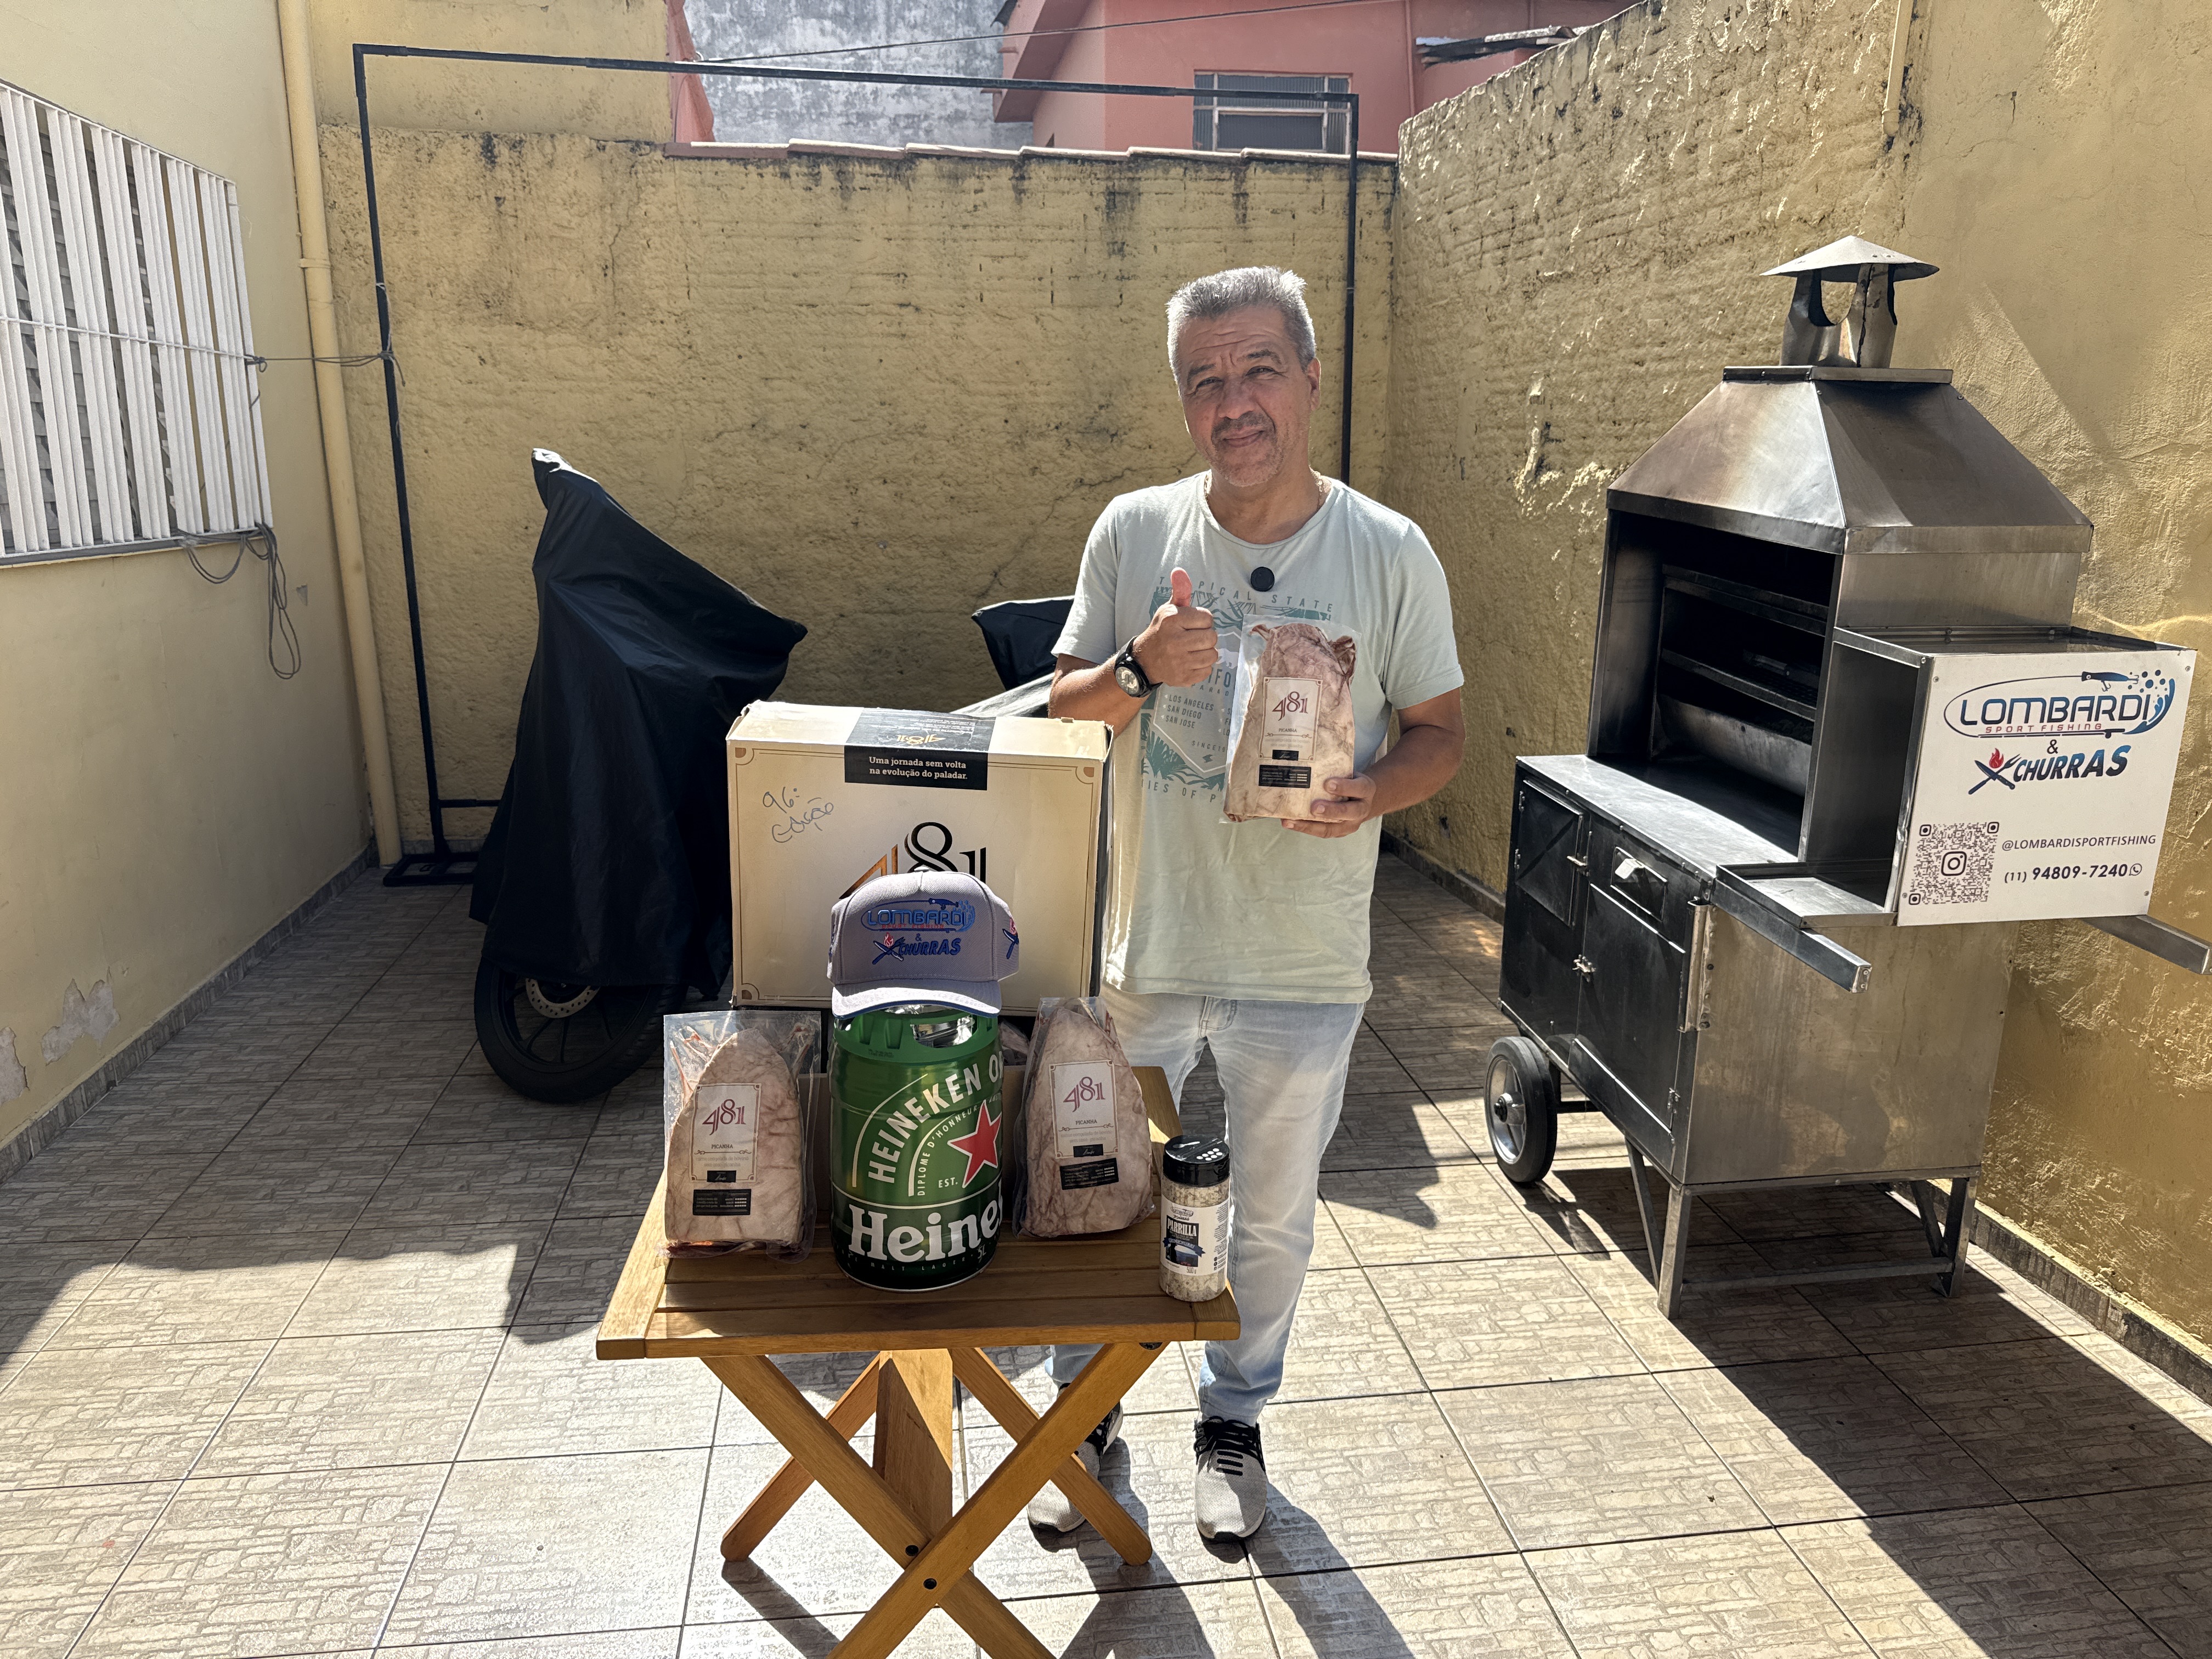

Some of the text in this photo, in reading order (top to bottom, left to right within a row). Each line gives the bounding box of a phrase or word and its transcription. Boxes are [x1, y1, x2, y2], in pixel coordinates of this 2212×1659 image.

[1160, 577, 1333, 612] TPICAL STATE
[1169, 694, 1214, 711] LOS ANGELES
[1272, 691, 1308, 721] 481
[1960, 694, 2151, 725] LOMBARDI
[1167, 705, 1202, 719] SAN DIEGO
[1165, 715, 1195, 729] SAN JOSE
[1985, 723, 2102, 733] SPORT FISHING
[2047, 739, 2058, 754] &
[869, 757, 889, 765] Uma
[890, 757, 923, 766] jornada
[945, 760, 967, 769] volta
[2013, 745, 2131, 782] CHURRAS
[882, 768, 920, 777] evolução
[934, 771, 968, 780] paladar.
[1182, 787, 1197, 799] OF
[2001, 835, 2157, 851] @LOMBARDISPORTFISHING
[2004, 864, 2128, 883] (11) 94809-7240
[867, 909, 967, 926] LOMBARDI
[899, 938, 962, 956] CHURRAS
[1063, 1076, 1105, 1112] 481
[702, 1099, 746, 1136] 481
[868, 1063, 981, 1183] HEINEKEN
[917, 1104, 978, 1196] DIPLOME D'HONNEUR
[938, 1177, 958, 1188] EST.
[1167, 1217, 1197, 1237] PARRILLA
[922, 1257, 965, 1271] LAGER
